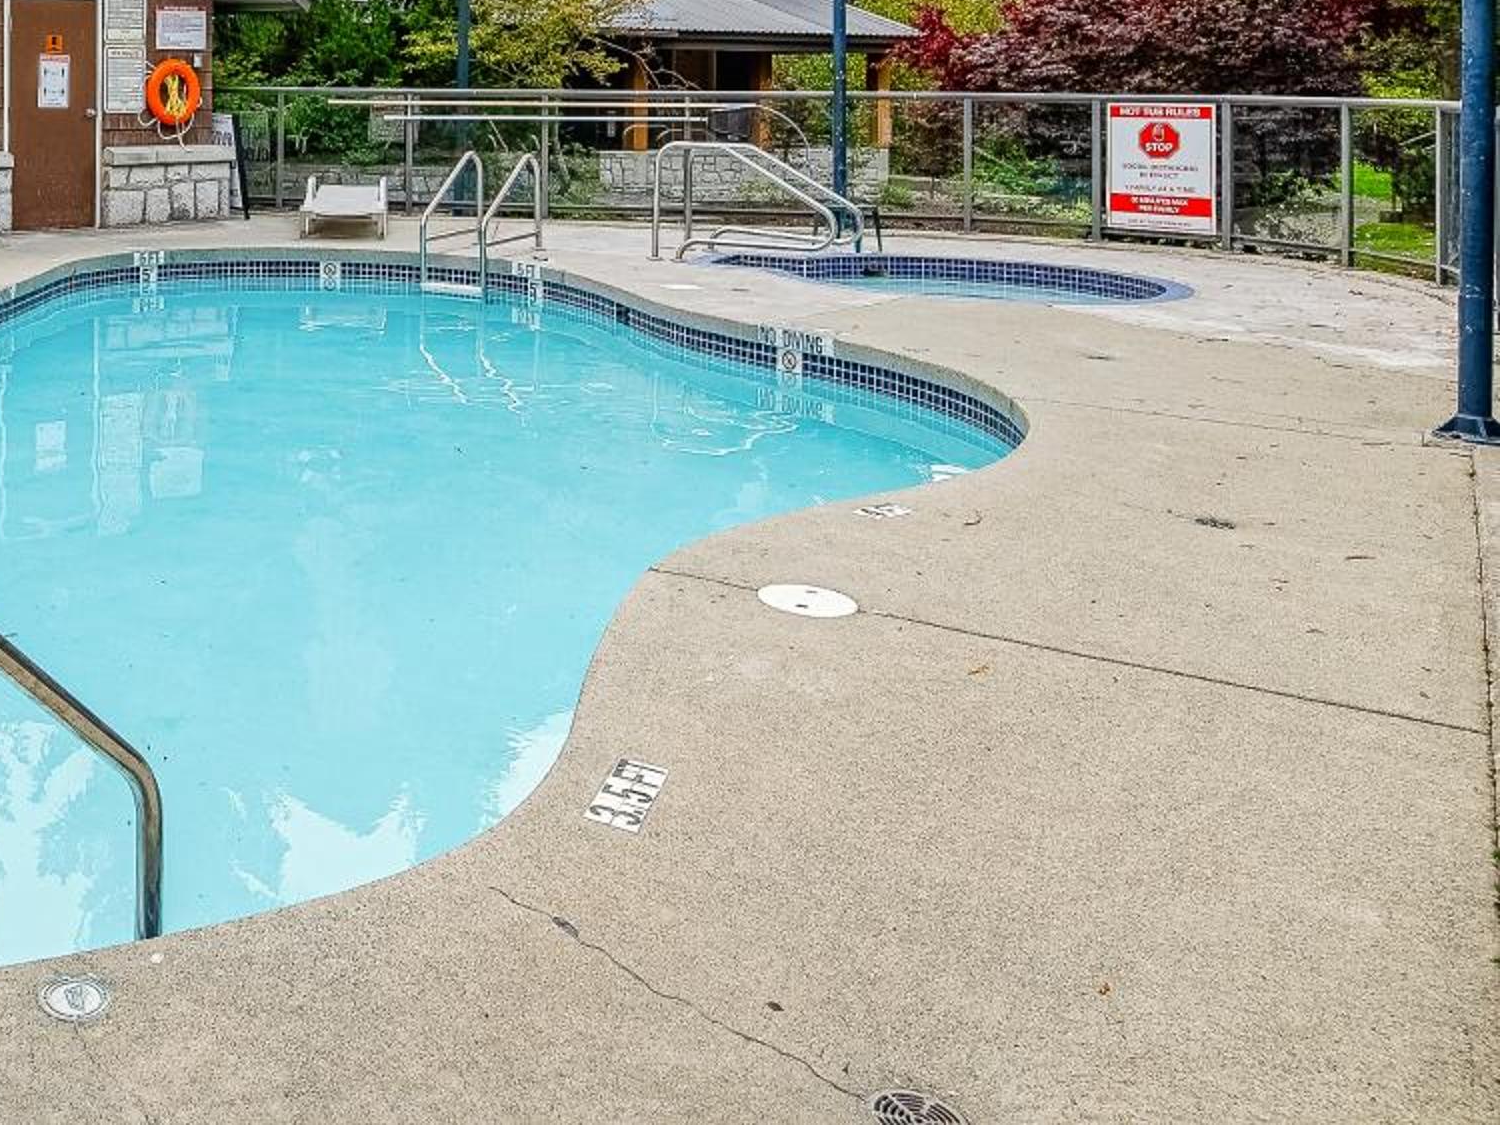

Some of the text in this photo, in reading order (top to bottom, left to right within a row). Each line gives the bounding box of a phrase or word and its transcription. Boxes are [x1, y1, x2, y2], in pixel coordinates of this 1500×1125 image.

[1120, 106, 1140, 116] HOT
[1165, 107, 1201, 118] RULES
[1145, 142, 1174, 152] STOP
[782, 330, 824, 354] DIVING
